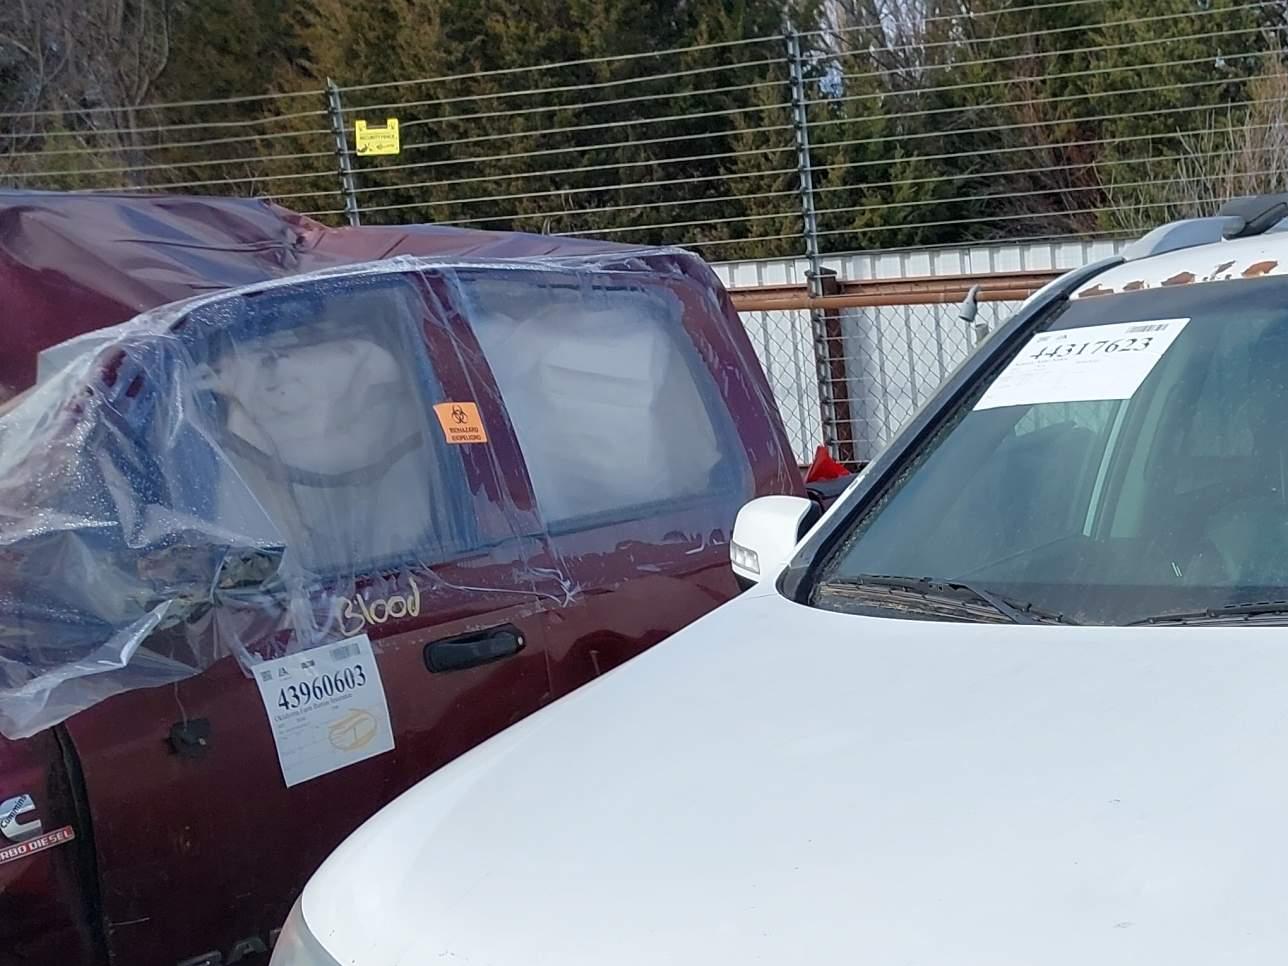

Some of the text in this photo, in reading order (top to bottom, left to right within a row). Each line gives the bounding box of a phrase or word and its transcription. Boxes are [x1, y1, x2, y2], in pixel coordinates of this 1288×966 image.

[1030, 337, 1154, 360] 44317623
[337, 577, 420, 637] Blood
[278, 664, 367, 710] 43960603
[0, 794, 27, 828] Cummins
[0, 828, 74, 861] RBO DIESEL
